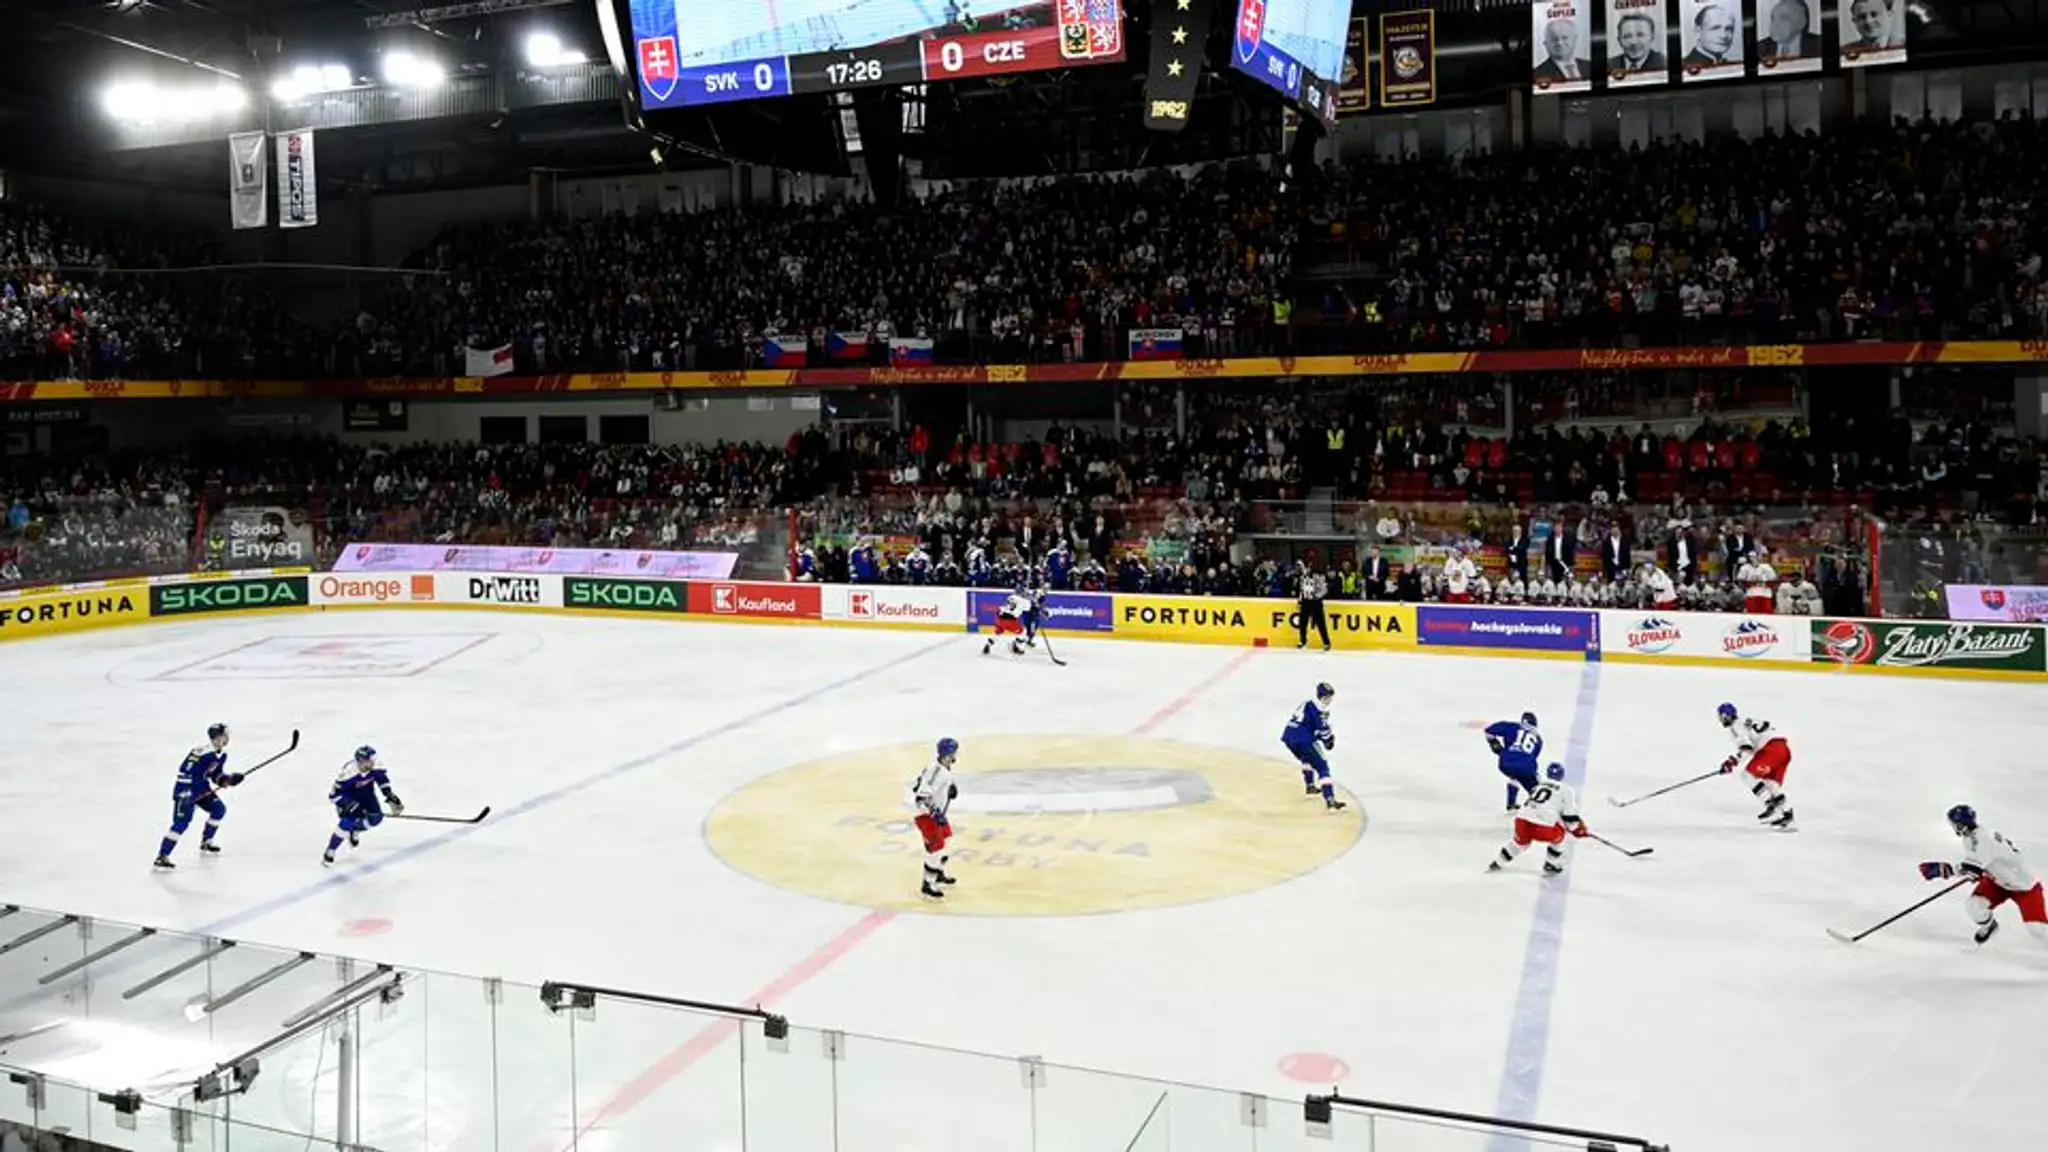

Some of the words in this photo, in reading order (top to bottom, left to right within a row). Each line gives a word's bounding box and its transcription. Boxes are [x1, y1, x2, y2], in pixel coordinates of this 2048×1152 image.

[705, 72, 740, 93] SVK
[754, 63, 773, 91] 0
[826, 60, 882, 84] 17:26
[942, 42, 963, 72] 0
[984, 41, 1026, 63] CZE
[1287, 63, 1297, 89] 0
[1151, 100, 1188, 119] 1962
[1746, 346, 1804, 366] 1962
[985, 365, 1027, 383] 1962
[230, 520, 281, 537] Škoda
[231, 540, 302, 560] Enyaq
[320, 577, 401, 601] Orange
[469, 576, 540, 602] DrWitt
[0, 596, 134, 627] FORTUNA
[738, 597, 796, 612] Kaufland
[876, 602, 939, 618] Kaufland
[1125, 606, 1245, 627] FORTUNA
[1471, 620, 1563, 635] hockeyslovakia
[1628, 629, 1682, 647] SLOVAKIA
[1723, 634, 1779, 651] SLOVAKIA
[1947, 623, 2030, 653] Bažant
[1513, 729, 1536, 752] 16
[836, 812, 1151, 858] FOTUNA
[870, 839, 1060, 870] DRBY
